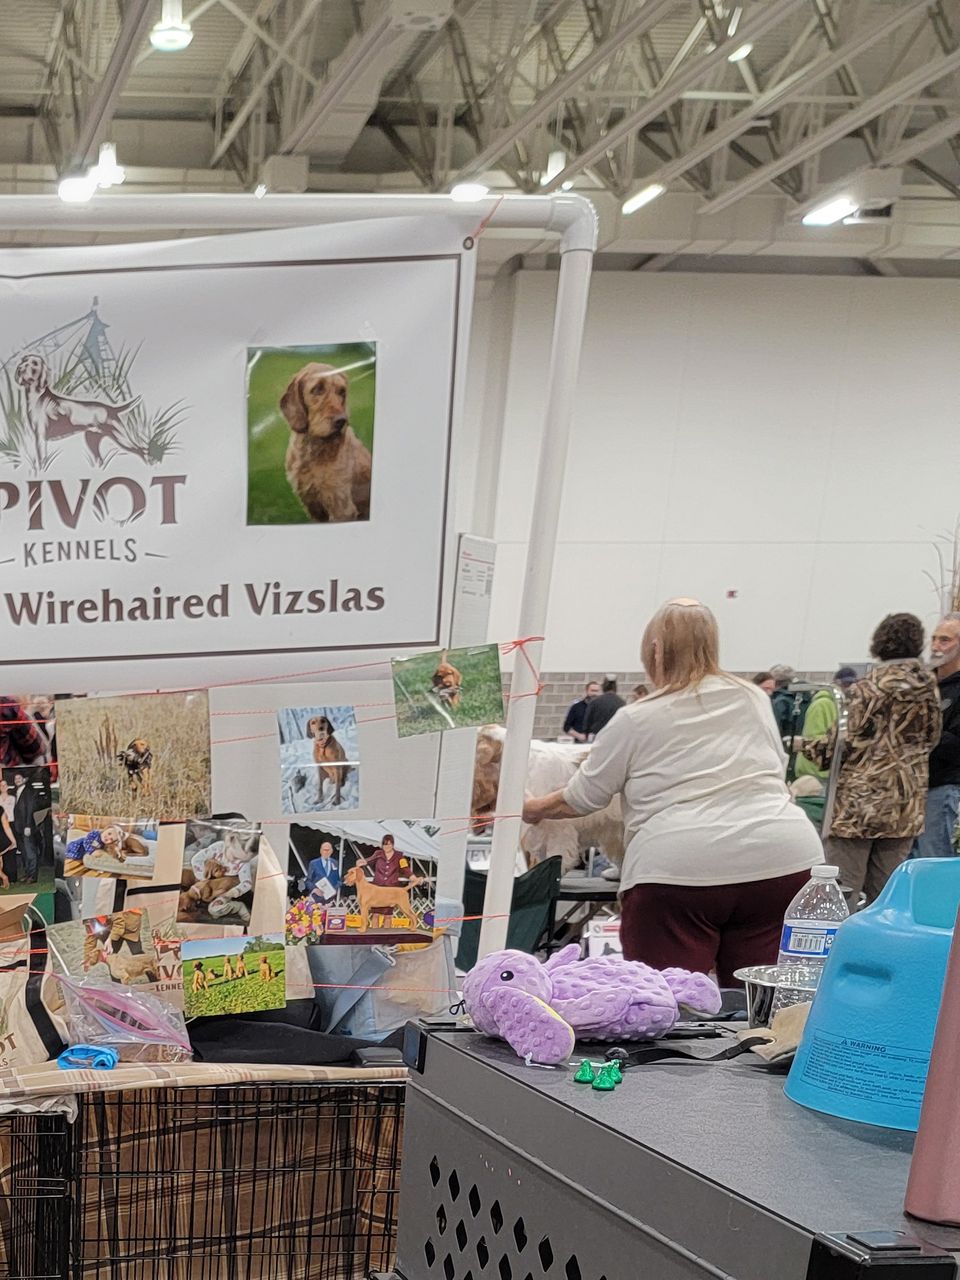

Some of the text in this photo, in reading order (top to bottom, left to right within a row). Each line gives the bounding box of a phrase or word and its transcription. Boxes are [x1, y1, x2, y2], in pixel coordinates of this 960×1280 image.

[23, 538, 137, 567] KENNELS
[3, 583, 230, 626] Wirehaired
[244, 579, 385, 616] Vizslas
[155, 983, 183, 992] KENNE
[849, 1040, 887, 1053] WARNING
